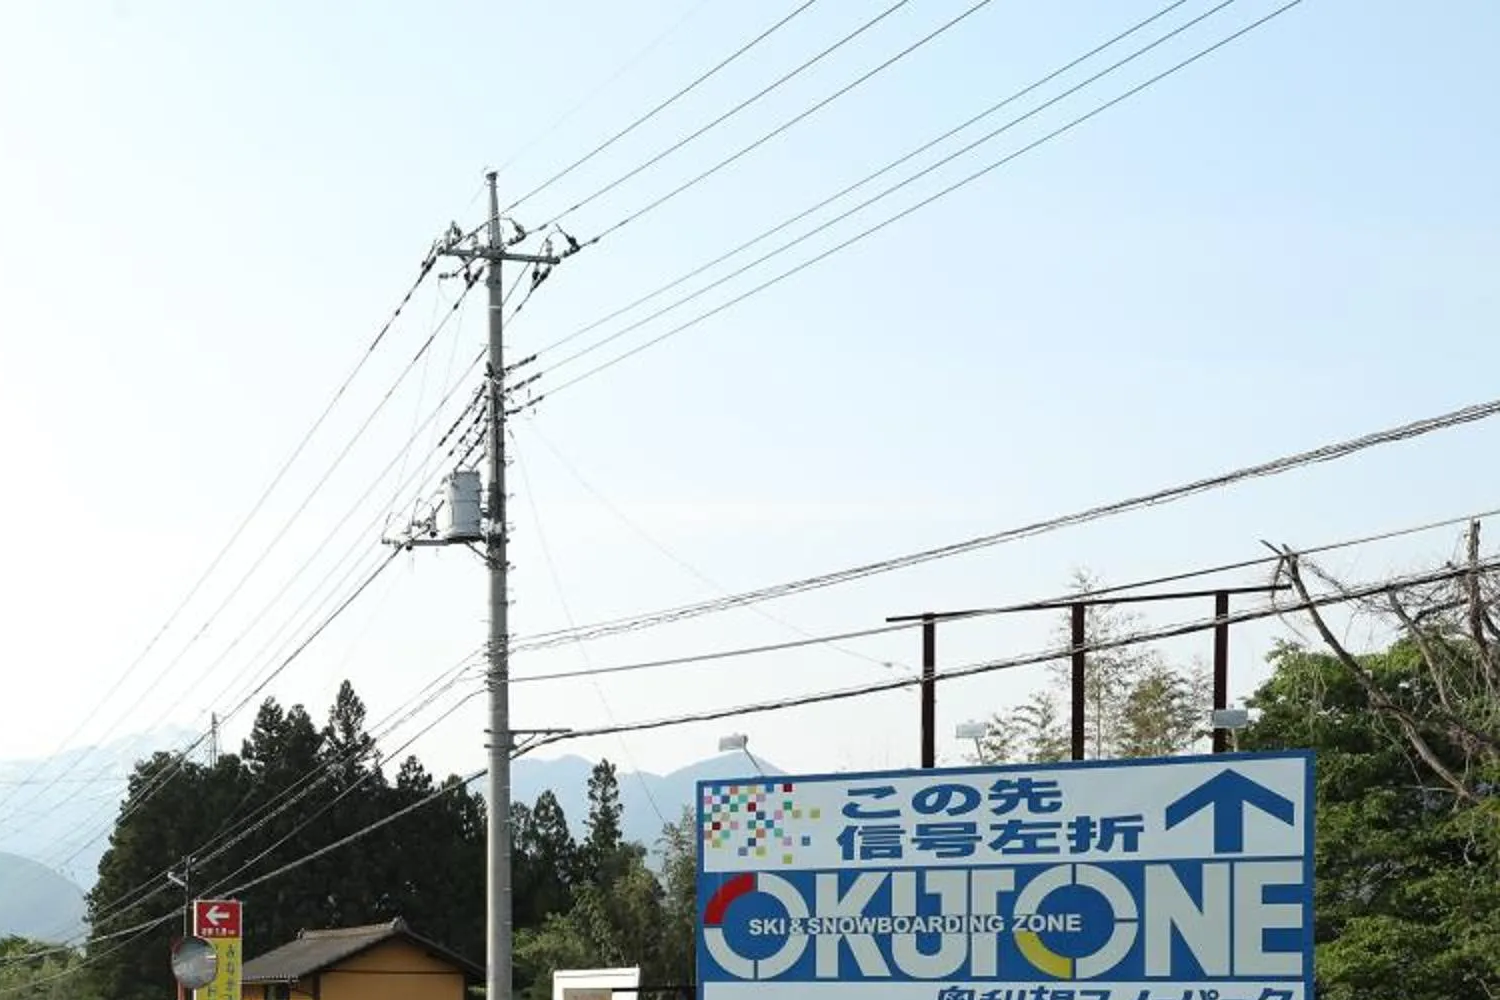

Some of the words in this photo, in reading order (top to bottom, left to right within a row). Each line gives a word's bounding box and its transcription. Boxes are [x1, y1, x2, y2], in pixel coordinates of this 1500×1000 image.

[841, 777, 1063, 819] この先
[835, 814, 1145, 860] 信号左折
[703, 863, 1303, 980] OKUTONE
[748, 919, 785, 936] SKI
[1011, 913, 1083, 933] ZONE
